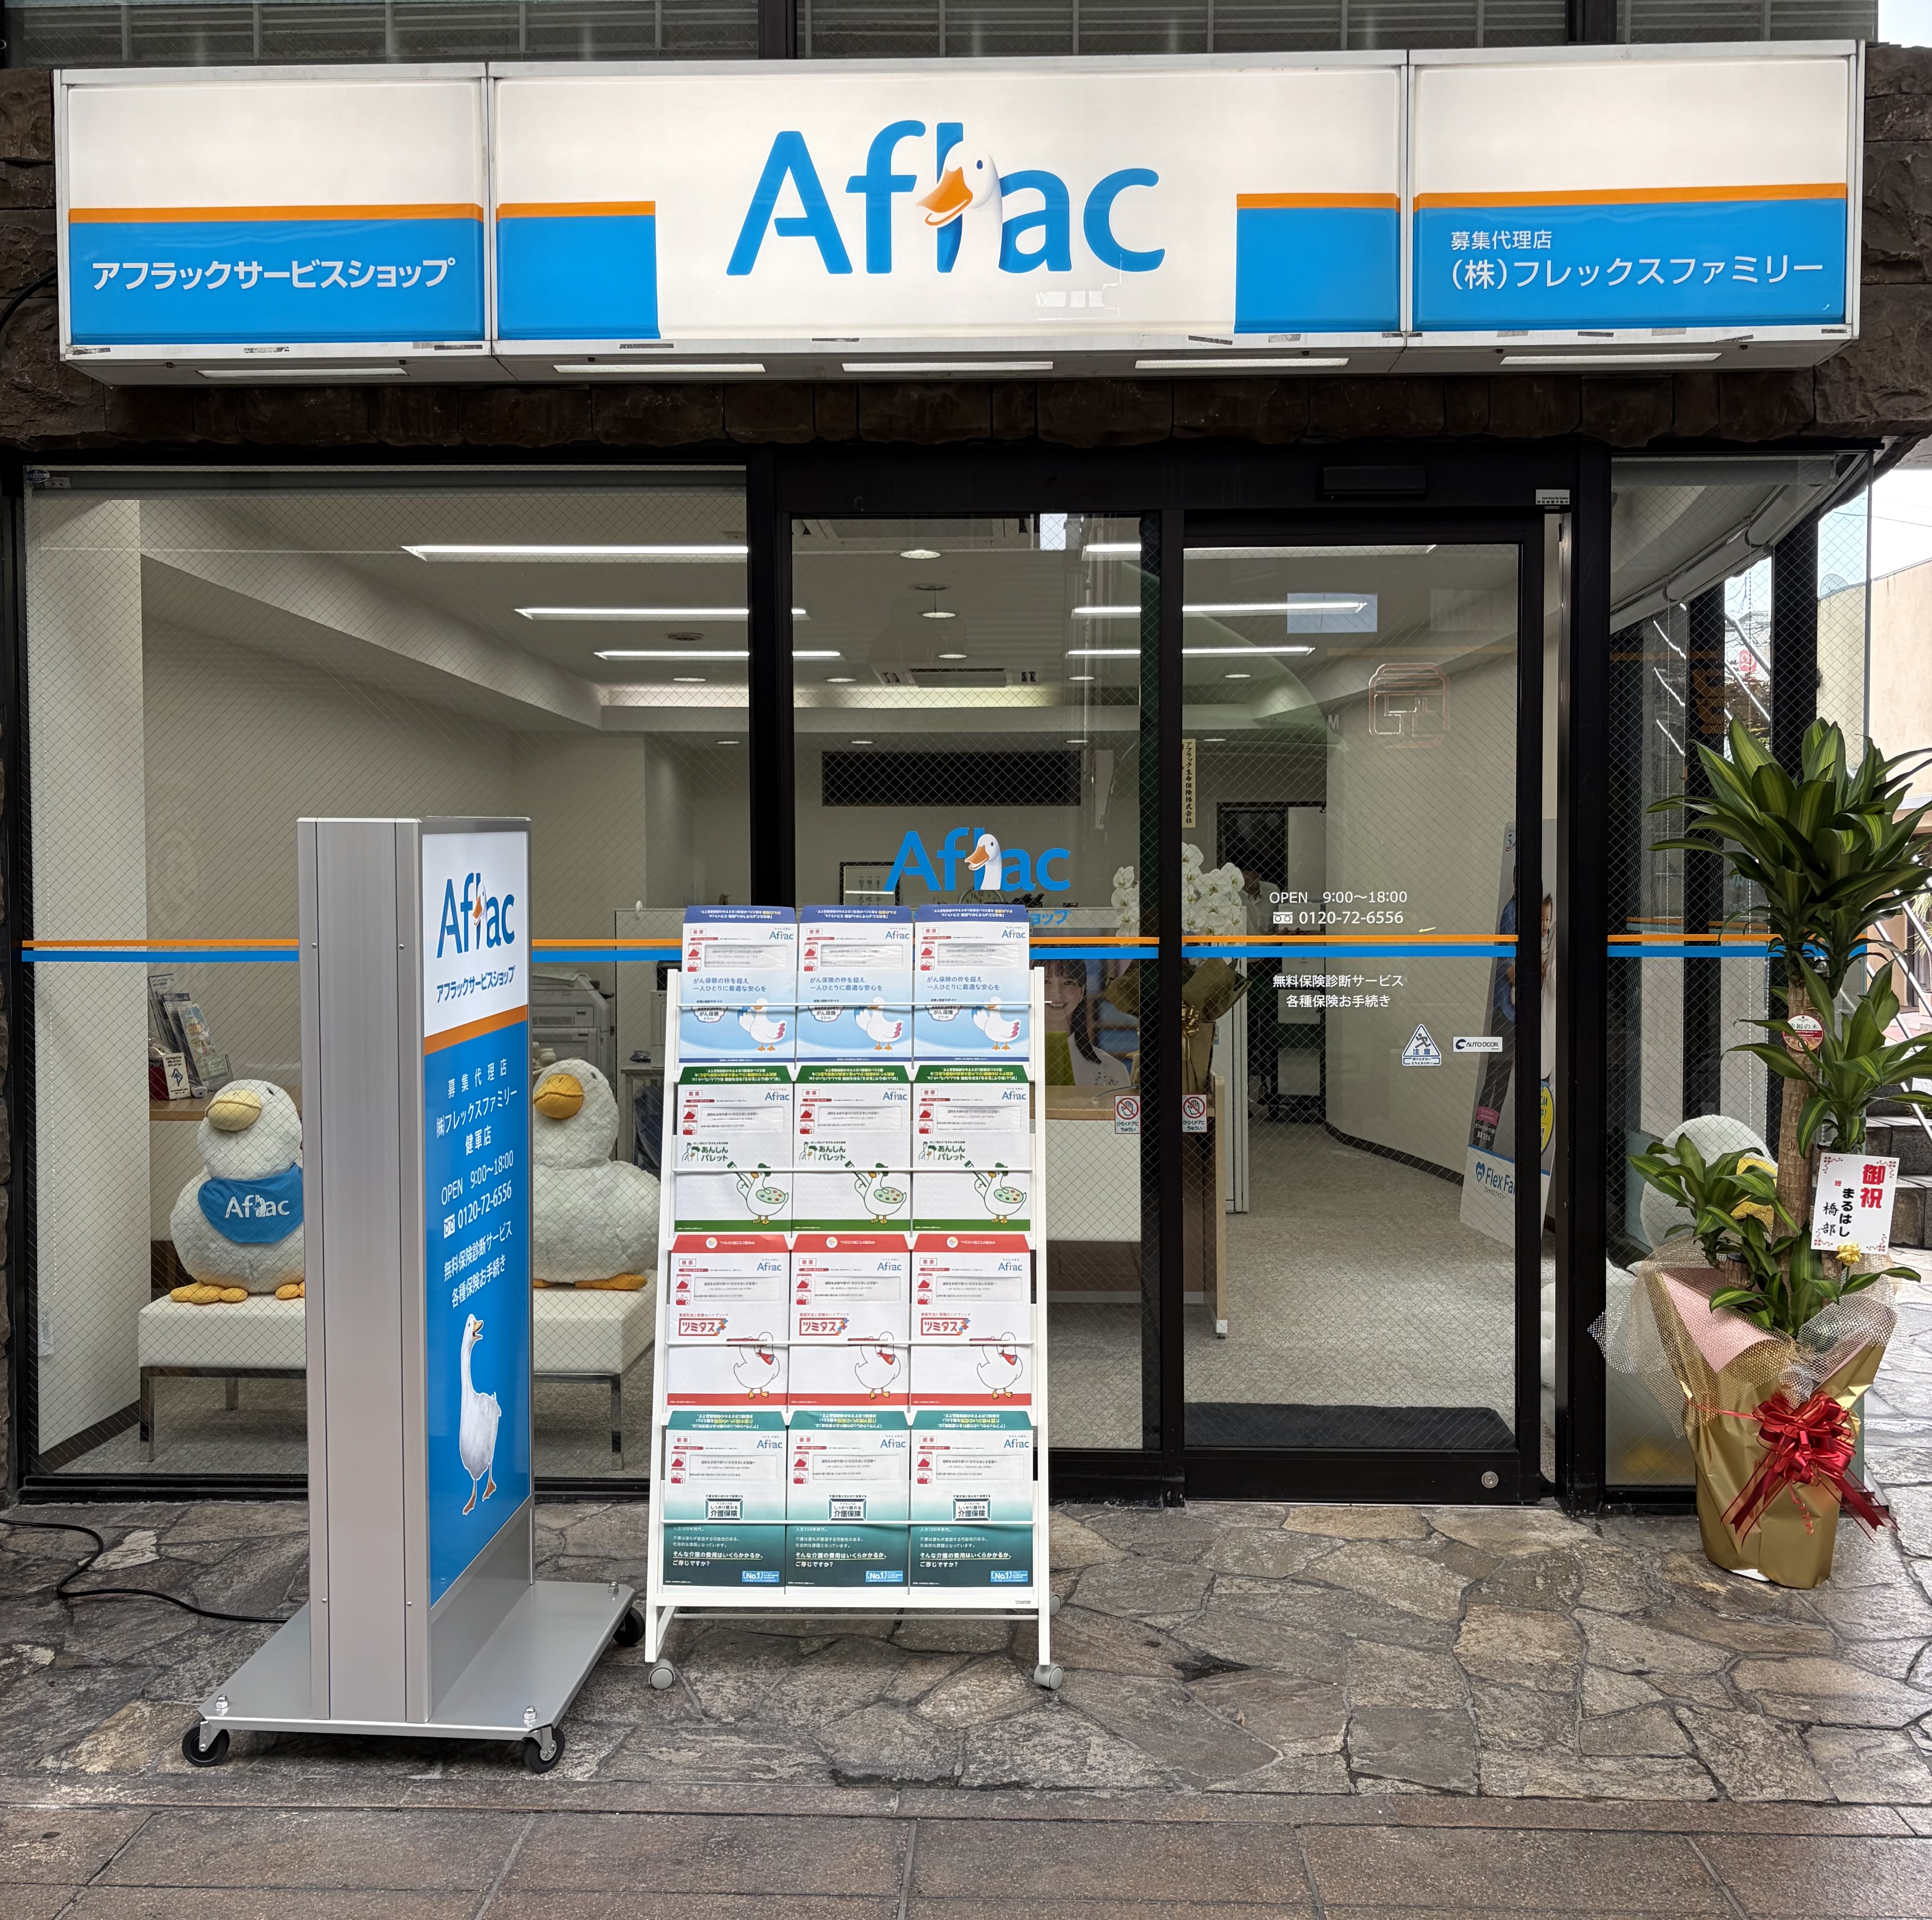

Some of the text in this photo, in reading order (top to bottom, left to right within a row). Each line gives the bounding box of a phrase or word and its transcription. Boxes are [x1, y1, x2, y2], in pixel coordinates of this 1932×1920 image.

[726, 120, 1166, 276] Aflac
[1450, 230, 1553, 251] 募集代理店
[92, 257, 456, 290] アフラックサービスショップ
[1451, 255, 1823, 291] (株)フレックスファミリー
[884, 827, 1071, 892] Aflac
[1269, 892, 1308, 903] OPEN
[437, 873, 515, 958] Aflac
[1299, 912, 1403, 924] 0120-72-6556
[769, 931, 793, 939] Aflac
[885, 931, 909, 939] Aflac
[1001, 930, 1026, 938] Aflac
[437, 965, 515, 1004] アフラックサービスショップ
[1273, 975, 1404, 987] 無料保険診断サービス
[1286, 995, 1390, 1008] 各種保険お手続き
[448, 1058, 507, 1099] 募集代理店
[465, 1125, 491, 1156] 健軍店
[441, 1178, 463, 1205] OPEN
[1485, 1167, 1515, 1194] Flex Fa
[1860, 1164, 1886, 1209] 御祝
[225, 1195, 290, 1218] Aflac
[458, 1180, 512, 1229] 0120-72-6556
[1839, 1188, 1855, 1237] まるはし
[1820, 1202, 1839, 1237] 橋部
[444, 1221, 512, 1282] 無料保険診断サービス
[452, 1254, 506, 1308] 各種保険お手続き
[682, 1322, 715, 1332] ツミタス
[803, 1322, 836, 1331] ツミタス
[924, 1321, 957, 1331] ツミタス
[994, 1571, 1012, 1579] No.1
